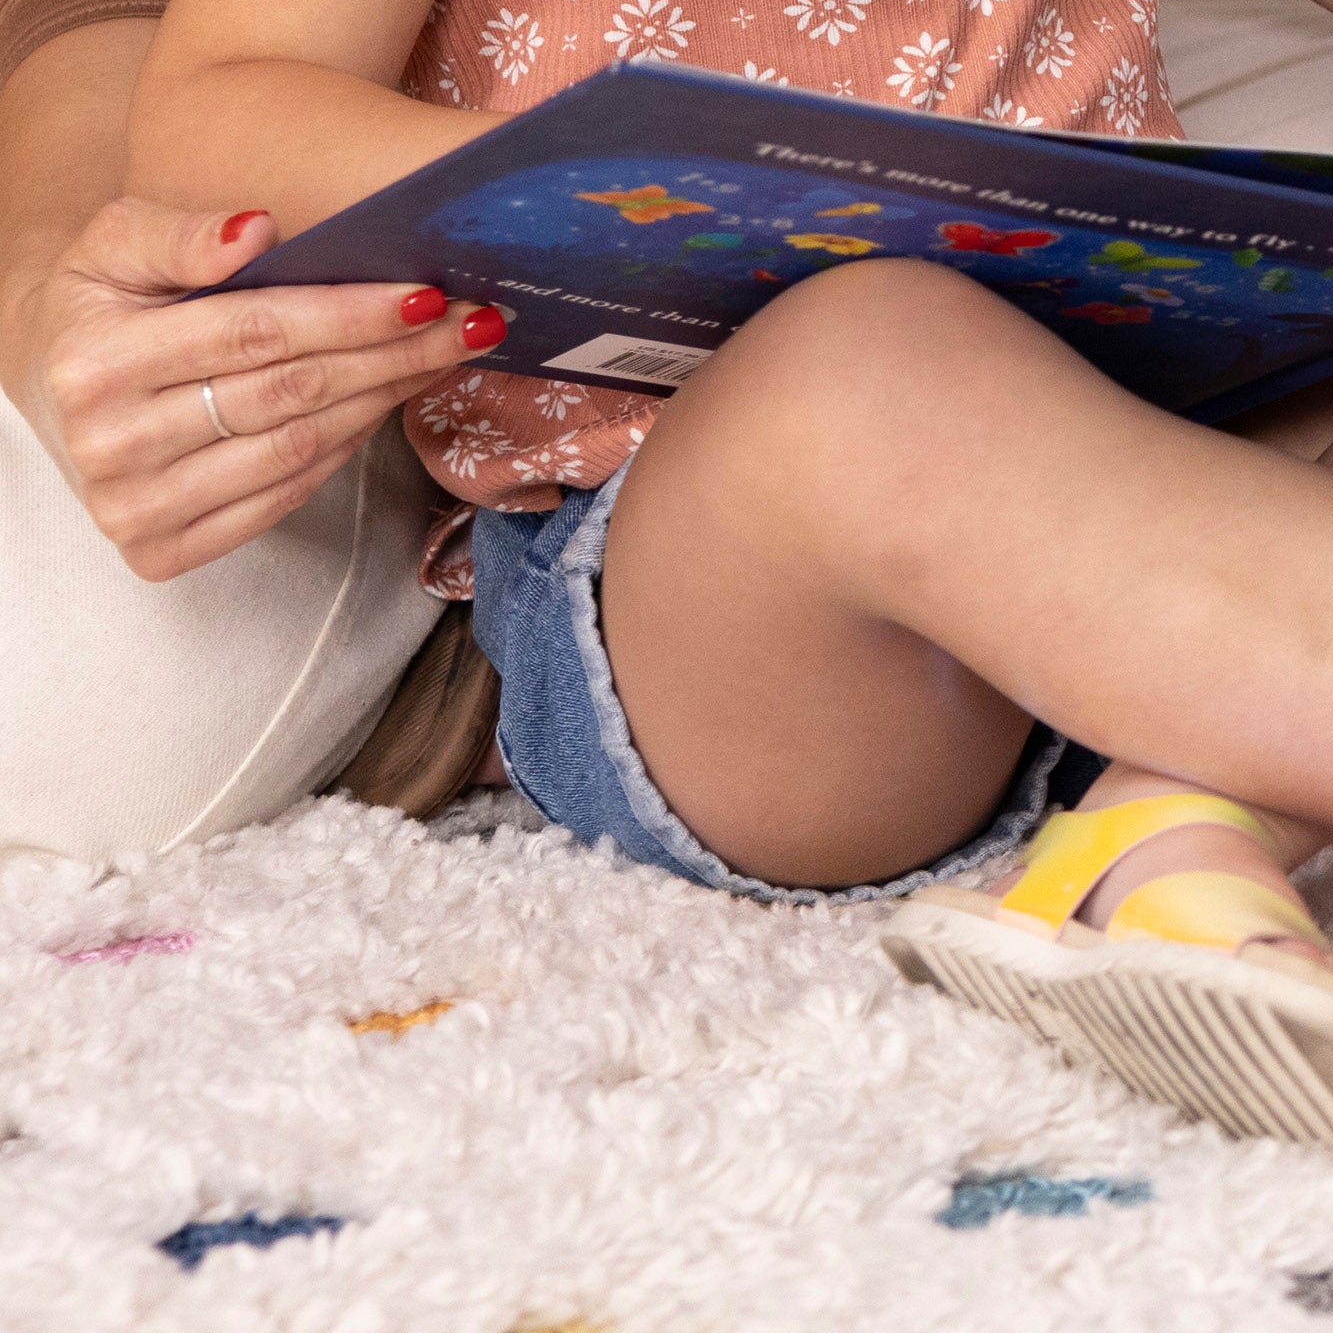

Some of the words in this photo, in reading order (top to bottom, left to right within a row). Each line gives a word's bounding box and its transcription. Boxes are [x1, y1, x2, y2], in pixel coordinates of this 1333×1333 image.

[884, 168, 973, 193] more
[976, 189, 1049, 212] than
[1053, 206, 1118, 225] one
[1126, 219, 1196, 238] way
[1202, 230, 1238, 242] to
[1247, 233, 1297, 250] fly
[496, 278, 563, 296] and
[560, 293, 642, 314] more
[648, 310, 721, 329] than
